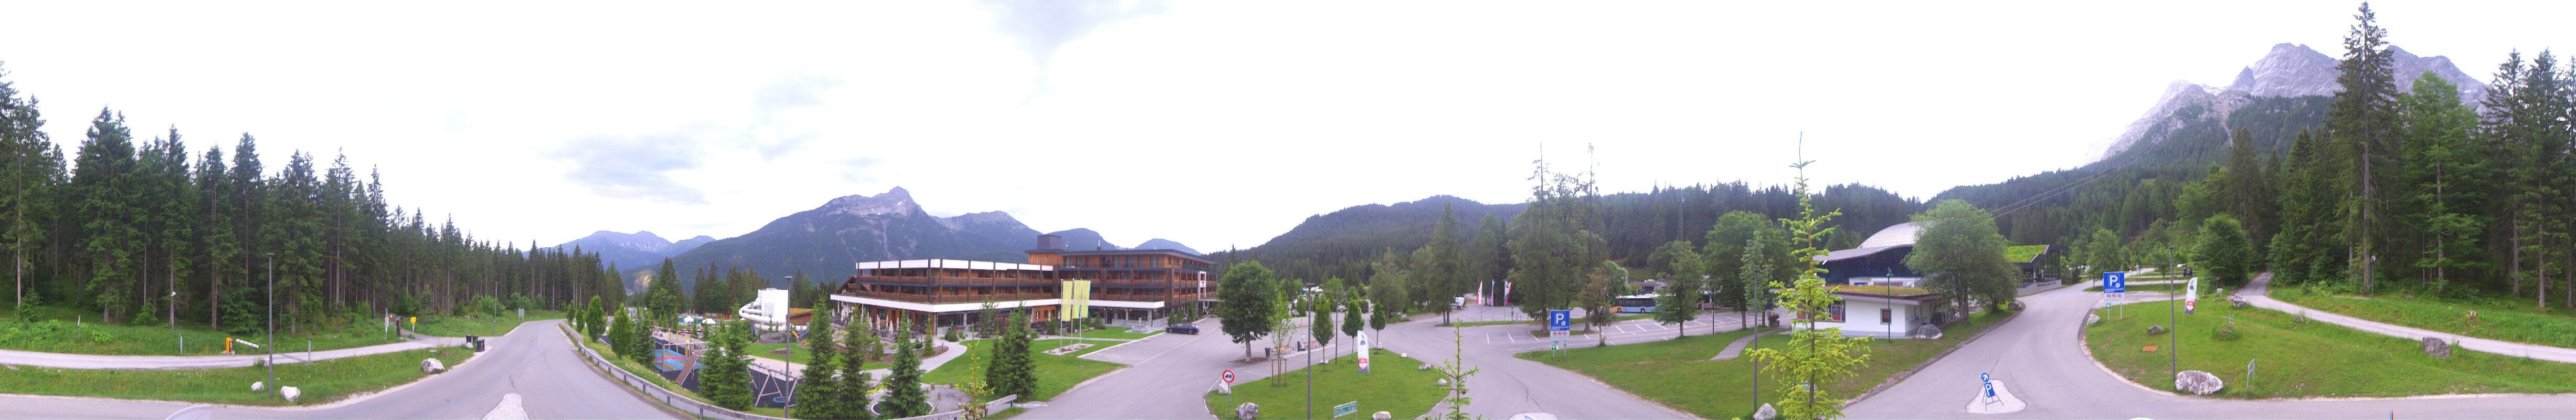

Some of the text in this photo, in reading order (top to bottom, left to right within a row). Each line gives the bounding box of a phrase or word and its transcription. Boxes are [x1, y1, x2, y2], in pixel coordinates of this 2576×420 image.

[2109, 275, 2118, 286] P
[1556, 313, 1564, 324] P
[1985, 384, 1991, 396] P
